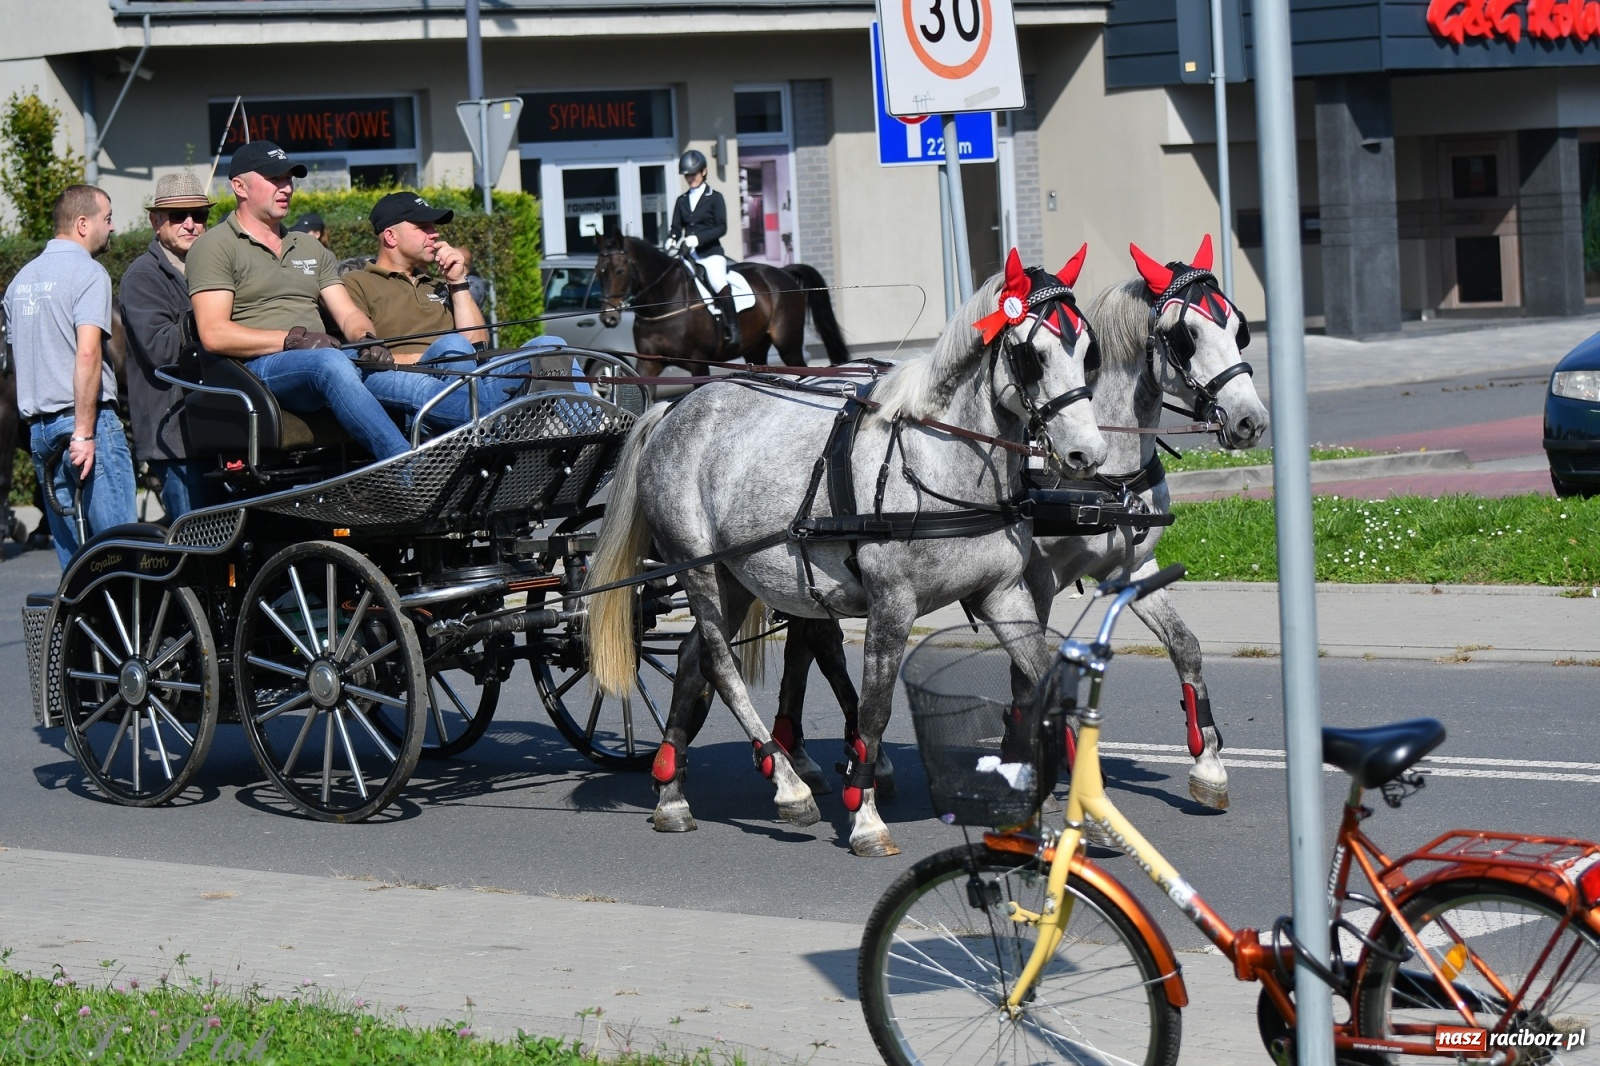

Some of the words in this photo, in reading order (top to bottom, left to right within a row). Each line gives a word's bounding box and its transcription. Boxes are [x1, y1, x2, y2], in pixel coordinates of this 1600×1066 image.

[920, 0, 980, 43] 30
[287, 109, 391, 146] WNĘKOWE
[548, 101, 637, 130] SYPIALNIE
[566, 199, 618, 213] raumplus
[140, 553, 169, 569] Aron
